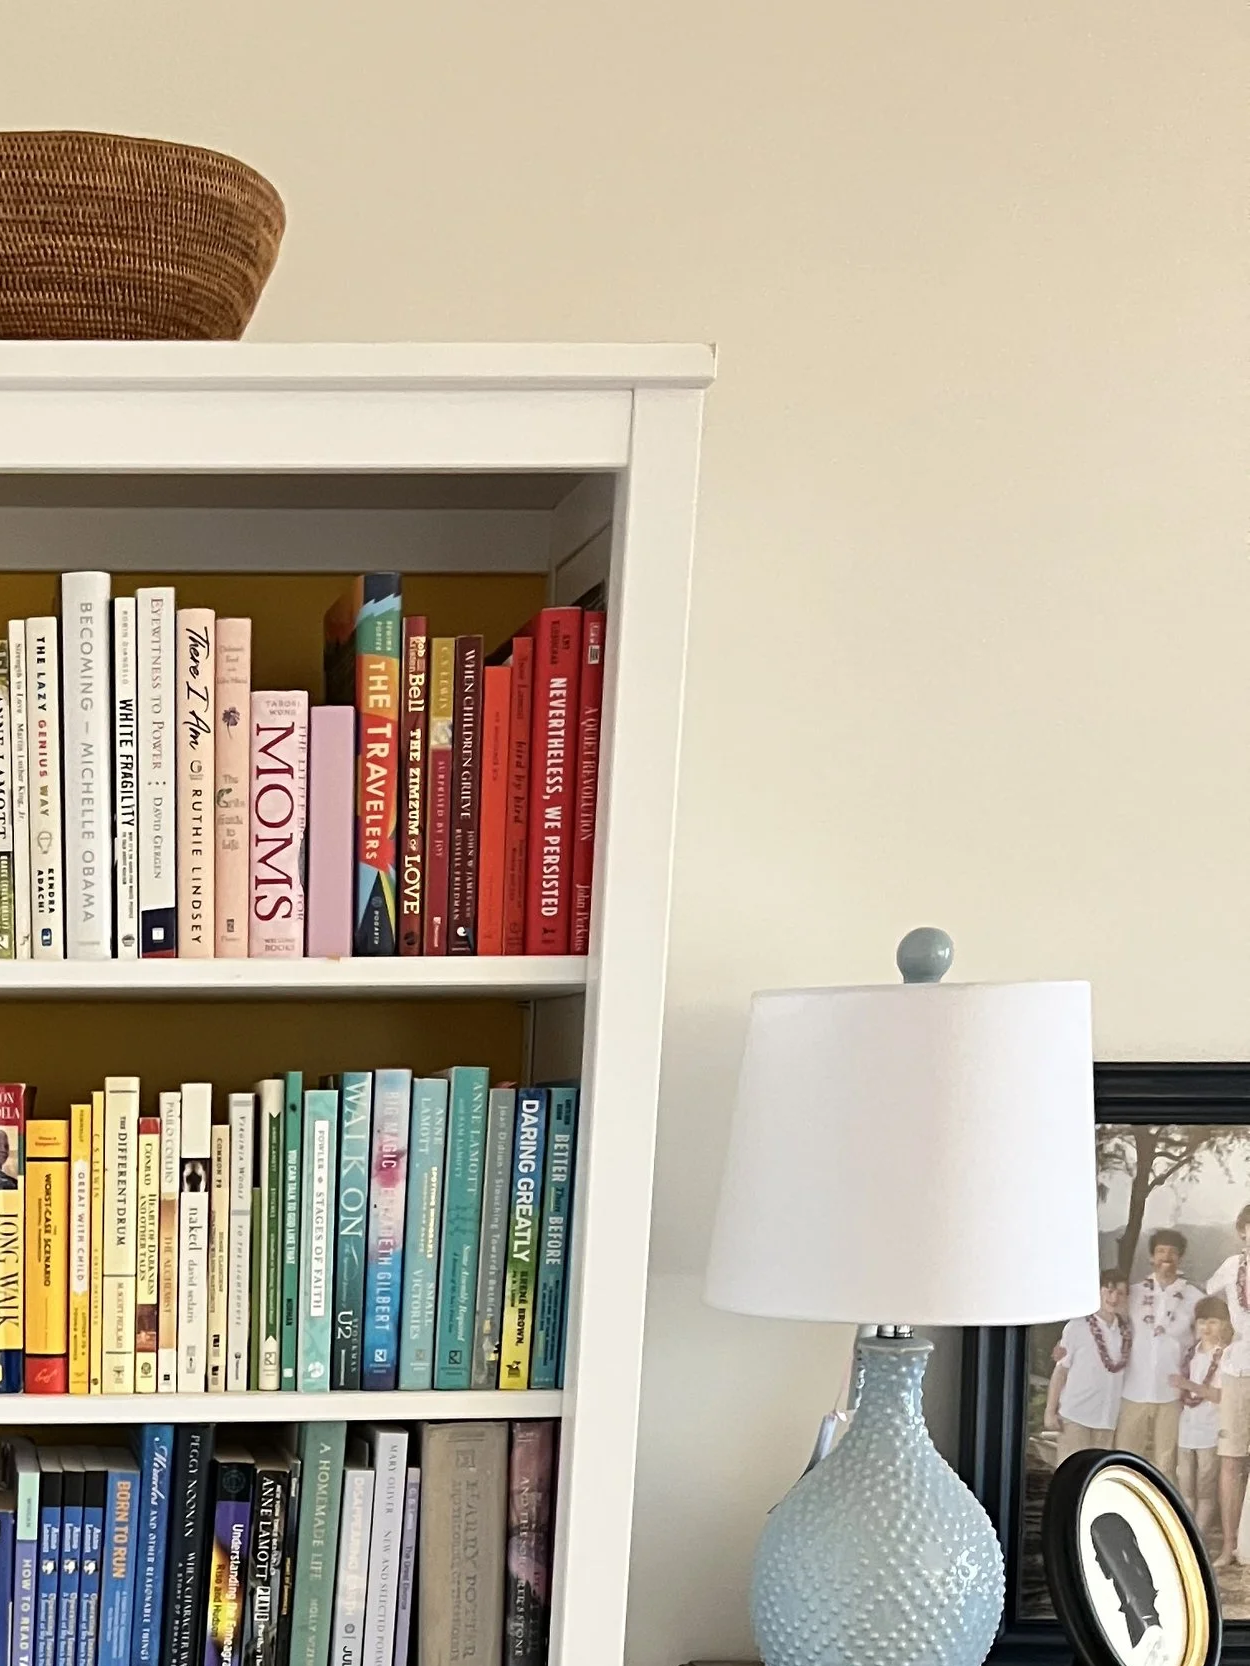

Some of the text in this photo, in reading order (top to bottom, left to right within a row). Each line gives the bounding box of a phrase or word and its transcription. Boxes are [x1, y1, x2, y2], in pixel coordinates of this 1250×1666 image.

[36, 637, 49, 816] THE LAZY GENIUS WAY
[181, 627, 211, 750] There I Am
[79, 603, 95, 923] BECOMING MICHELLE OBAMA
[118, 699, 134, 826] WHITE FRAGILITY
[254, 722, 295, 922] MOMS
[365, 662, 392, 859] THE TRAVELERS
[541, 678, 567, 917] NEVERTHELESS, WE PERSISTED
[116, 1133, 127, 1246] DIFFERENT DRUM
[315, 1192, 324, 1240] STAGES
[340, 1082, 369, 1238] WALK ON
[513, 1099, 539, 1263] DARING GREATLY
[315, 1246, 323, 1264] OF
[337, 1310, 352, 1339] U2
[320, 1442, 331, 1454] A
[113, 1481, 131, 1578] BORN TO RUN
[256, 1477, 274, 1581] ANNE LAMOTT
